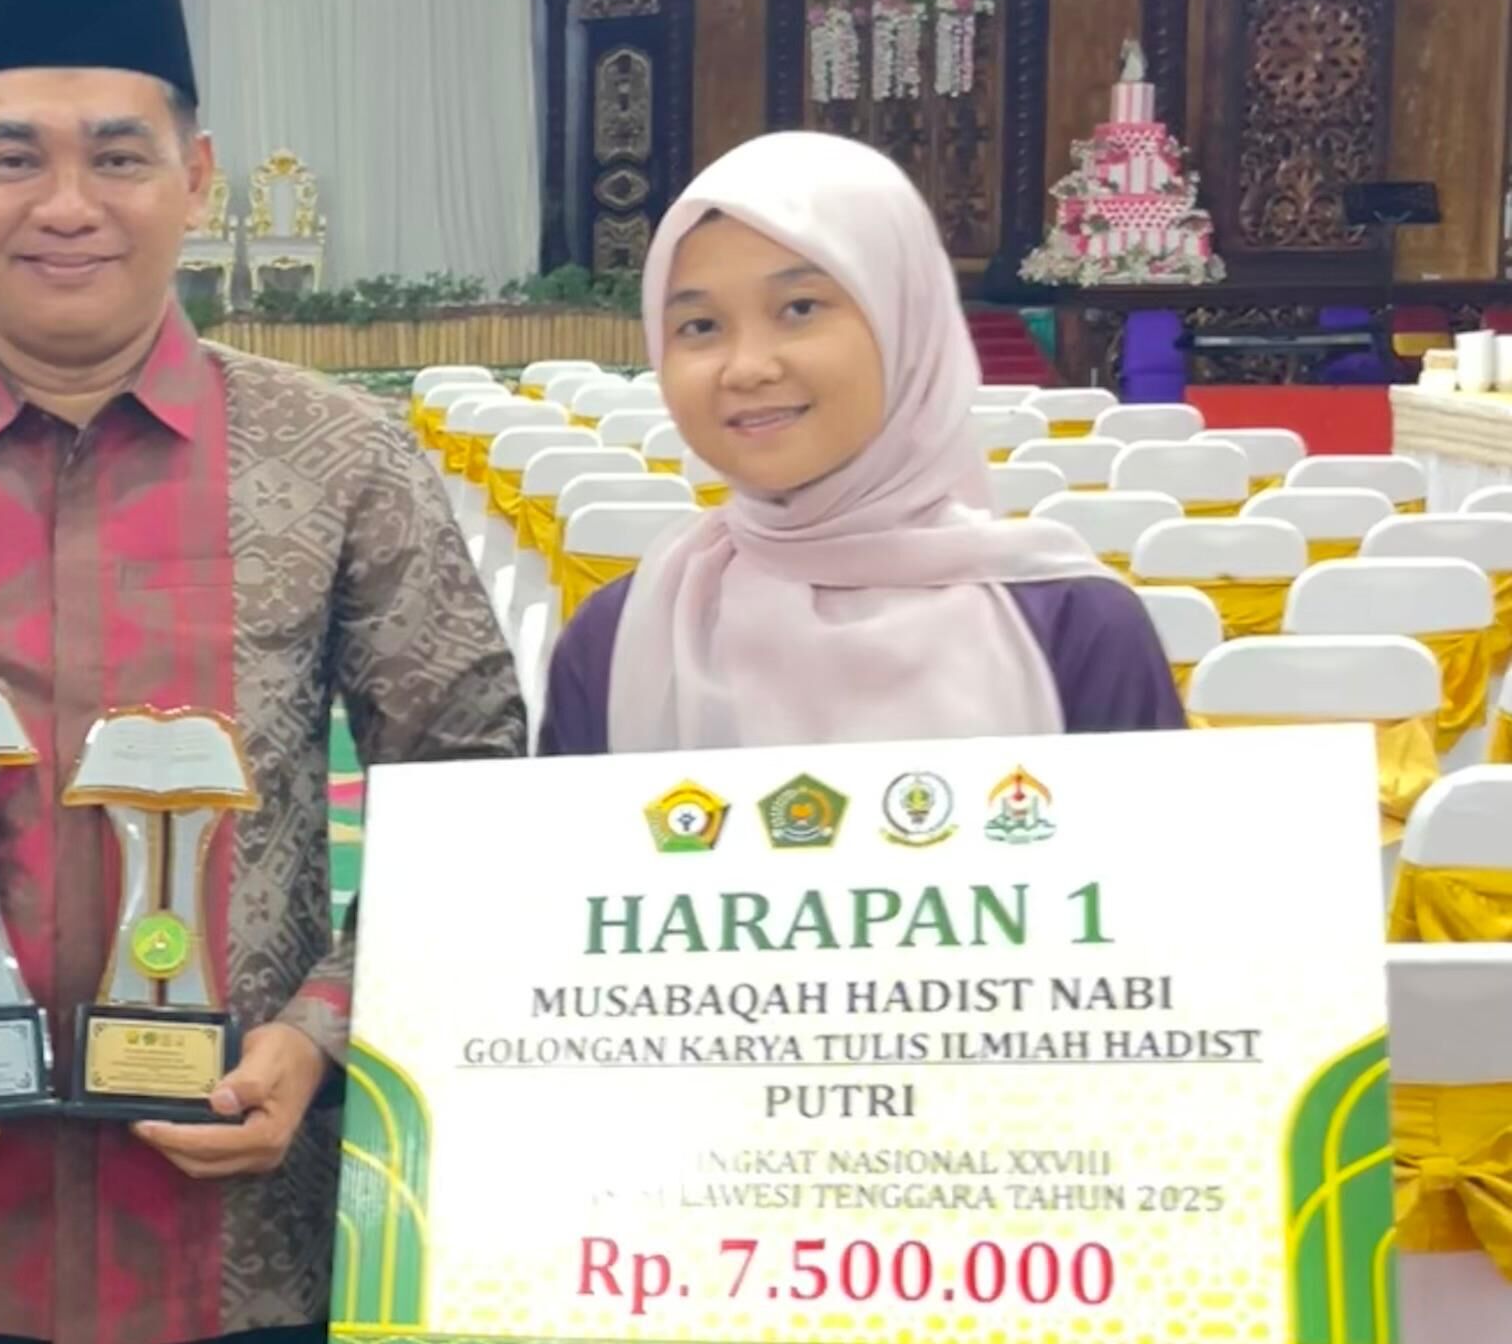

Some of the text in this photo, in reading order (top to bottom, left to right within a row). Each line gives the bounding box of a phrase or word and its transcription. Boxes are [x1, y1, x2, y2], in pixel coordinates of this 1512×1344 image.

[583, 881, 1114, 954] HARAPAN 1
[531, 976, 1172, 1023] MUSABAQAH HADIST NABI
[463, 1029, 1260, 1064] GOLONGAN KARYA TULIS ILMIAH HADIST
[765, 1084, 913, 1118] PUTRI
[827, 1149, 997, 1174] NASIONAL
[1007, 1149, 1110, 1174] XXVIII
[813, 1184, 995, 1209] TENGGARA
[1005, 1184, 1125, 1210] TAHUN
[1137, 1186, 1224, 1211] 2025
[576, 1236, 1114, 1315] Rp. 7.500.000
